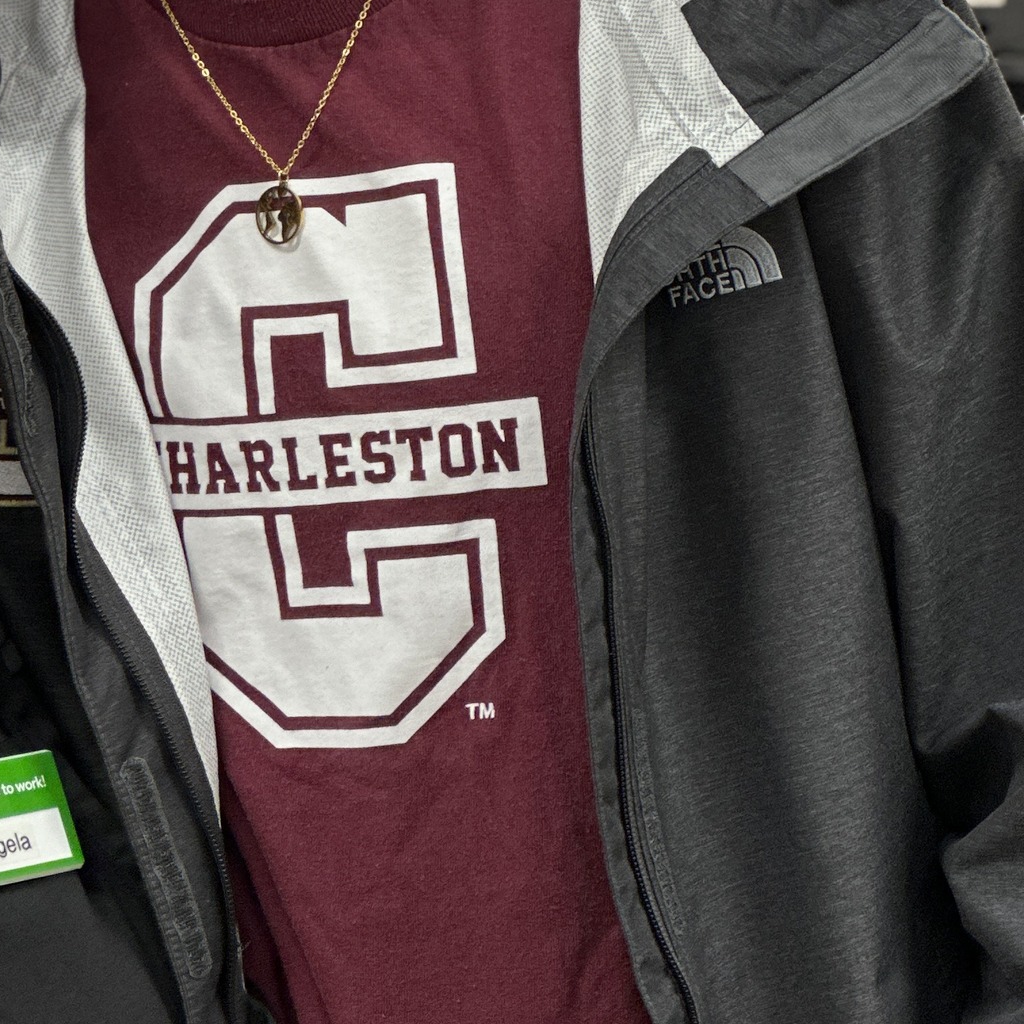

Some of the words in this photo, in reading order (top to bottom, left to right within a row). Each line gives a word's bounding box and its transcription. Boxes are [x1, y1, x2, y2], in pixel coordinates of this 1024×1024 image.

[668, 272, 734, 307] FACE
[155, 417, 521, 495] HARLESTON
[466, 703, 496, 720] TM
[1, 783, 15, 795] to
[15, 775, 47, 793] work!
